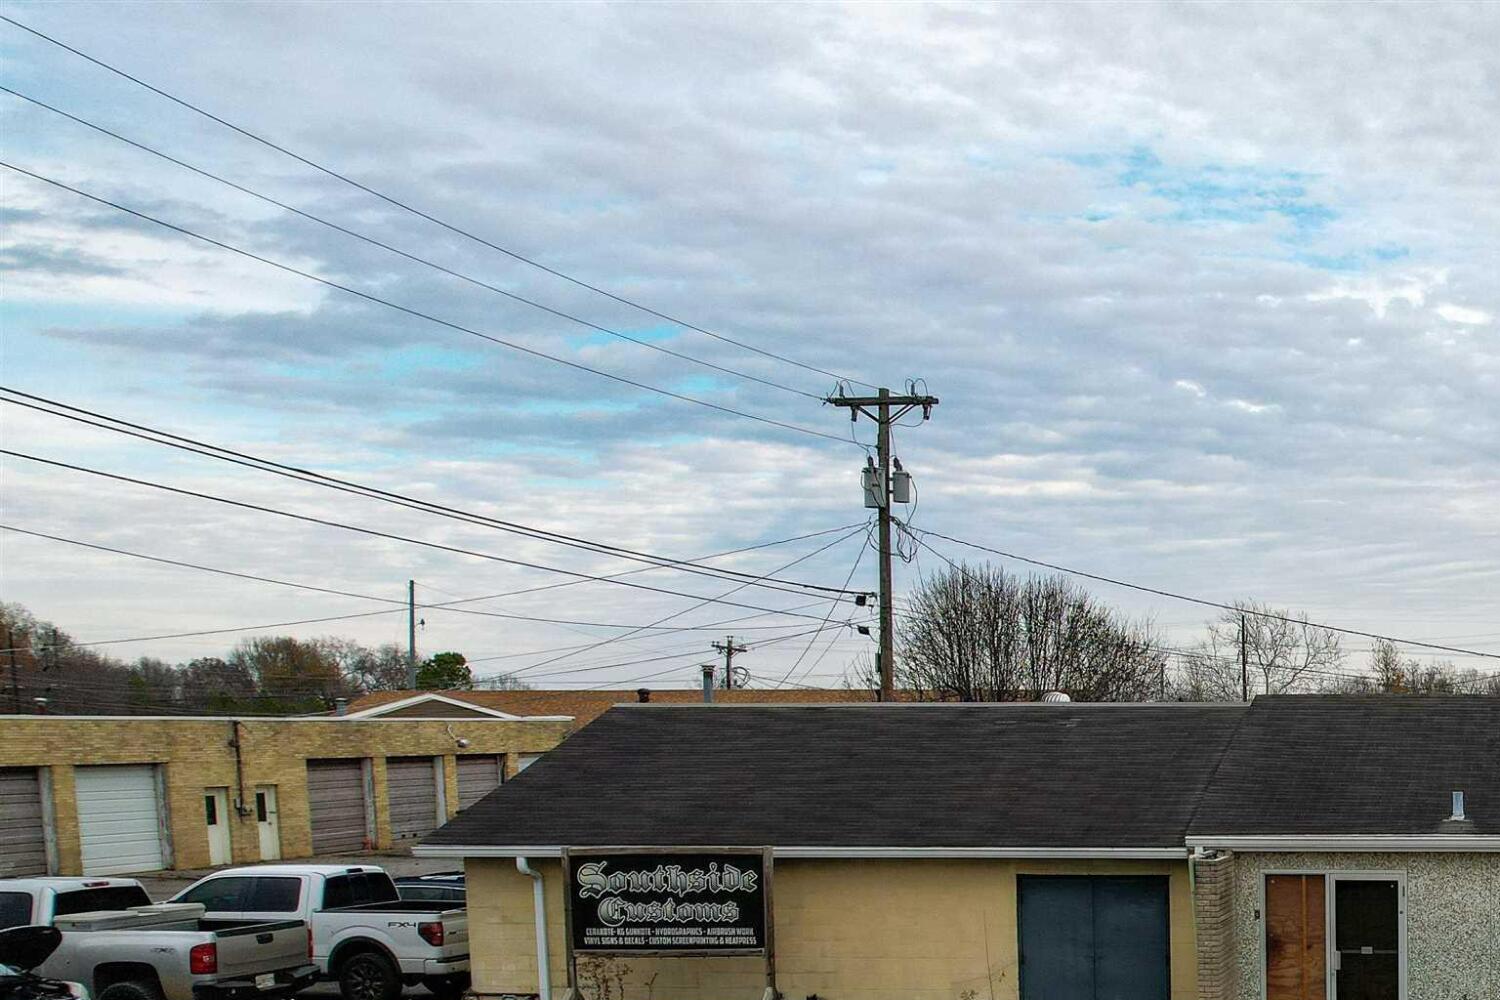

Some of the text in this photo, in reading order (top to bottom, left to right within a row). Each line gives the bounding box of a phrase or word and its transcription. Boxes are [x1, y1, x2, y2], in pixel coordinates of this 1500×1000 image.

[577, 861, 758, 898] Southside
[598, 897, 740, 927] Customs
[648, 936, 672, 945] CUSTOM
